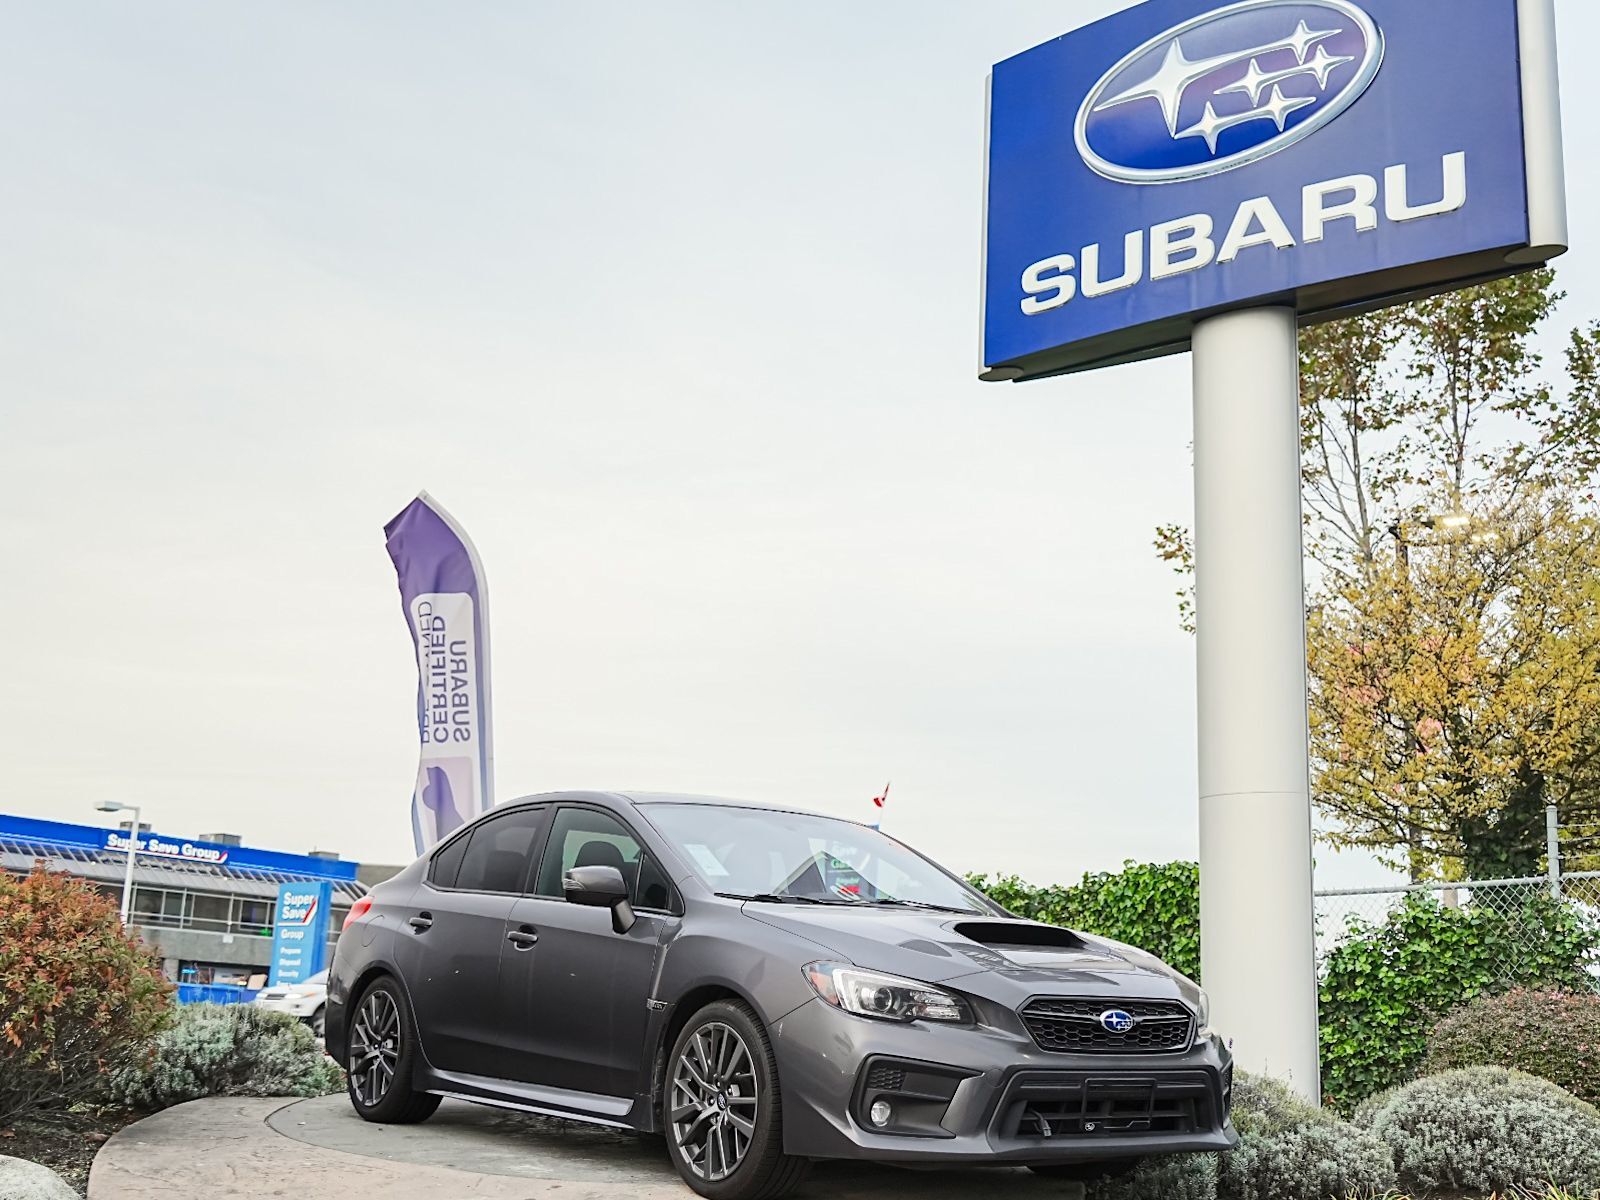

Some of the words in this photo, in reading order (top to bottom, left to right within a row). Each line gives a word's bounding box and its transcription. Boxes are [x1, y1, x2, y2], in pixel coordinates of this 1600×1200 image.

[1020, 151, 1466, 316] SUBARU
[149, 839, 180, 854] Save
[181, 843, 220, 861] Group
[283, 891, 315, 907] Super
[282, 906, 307, 919] Save
